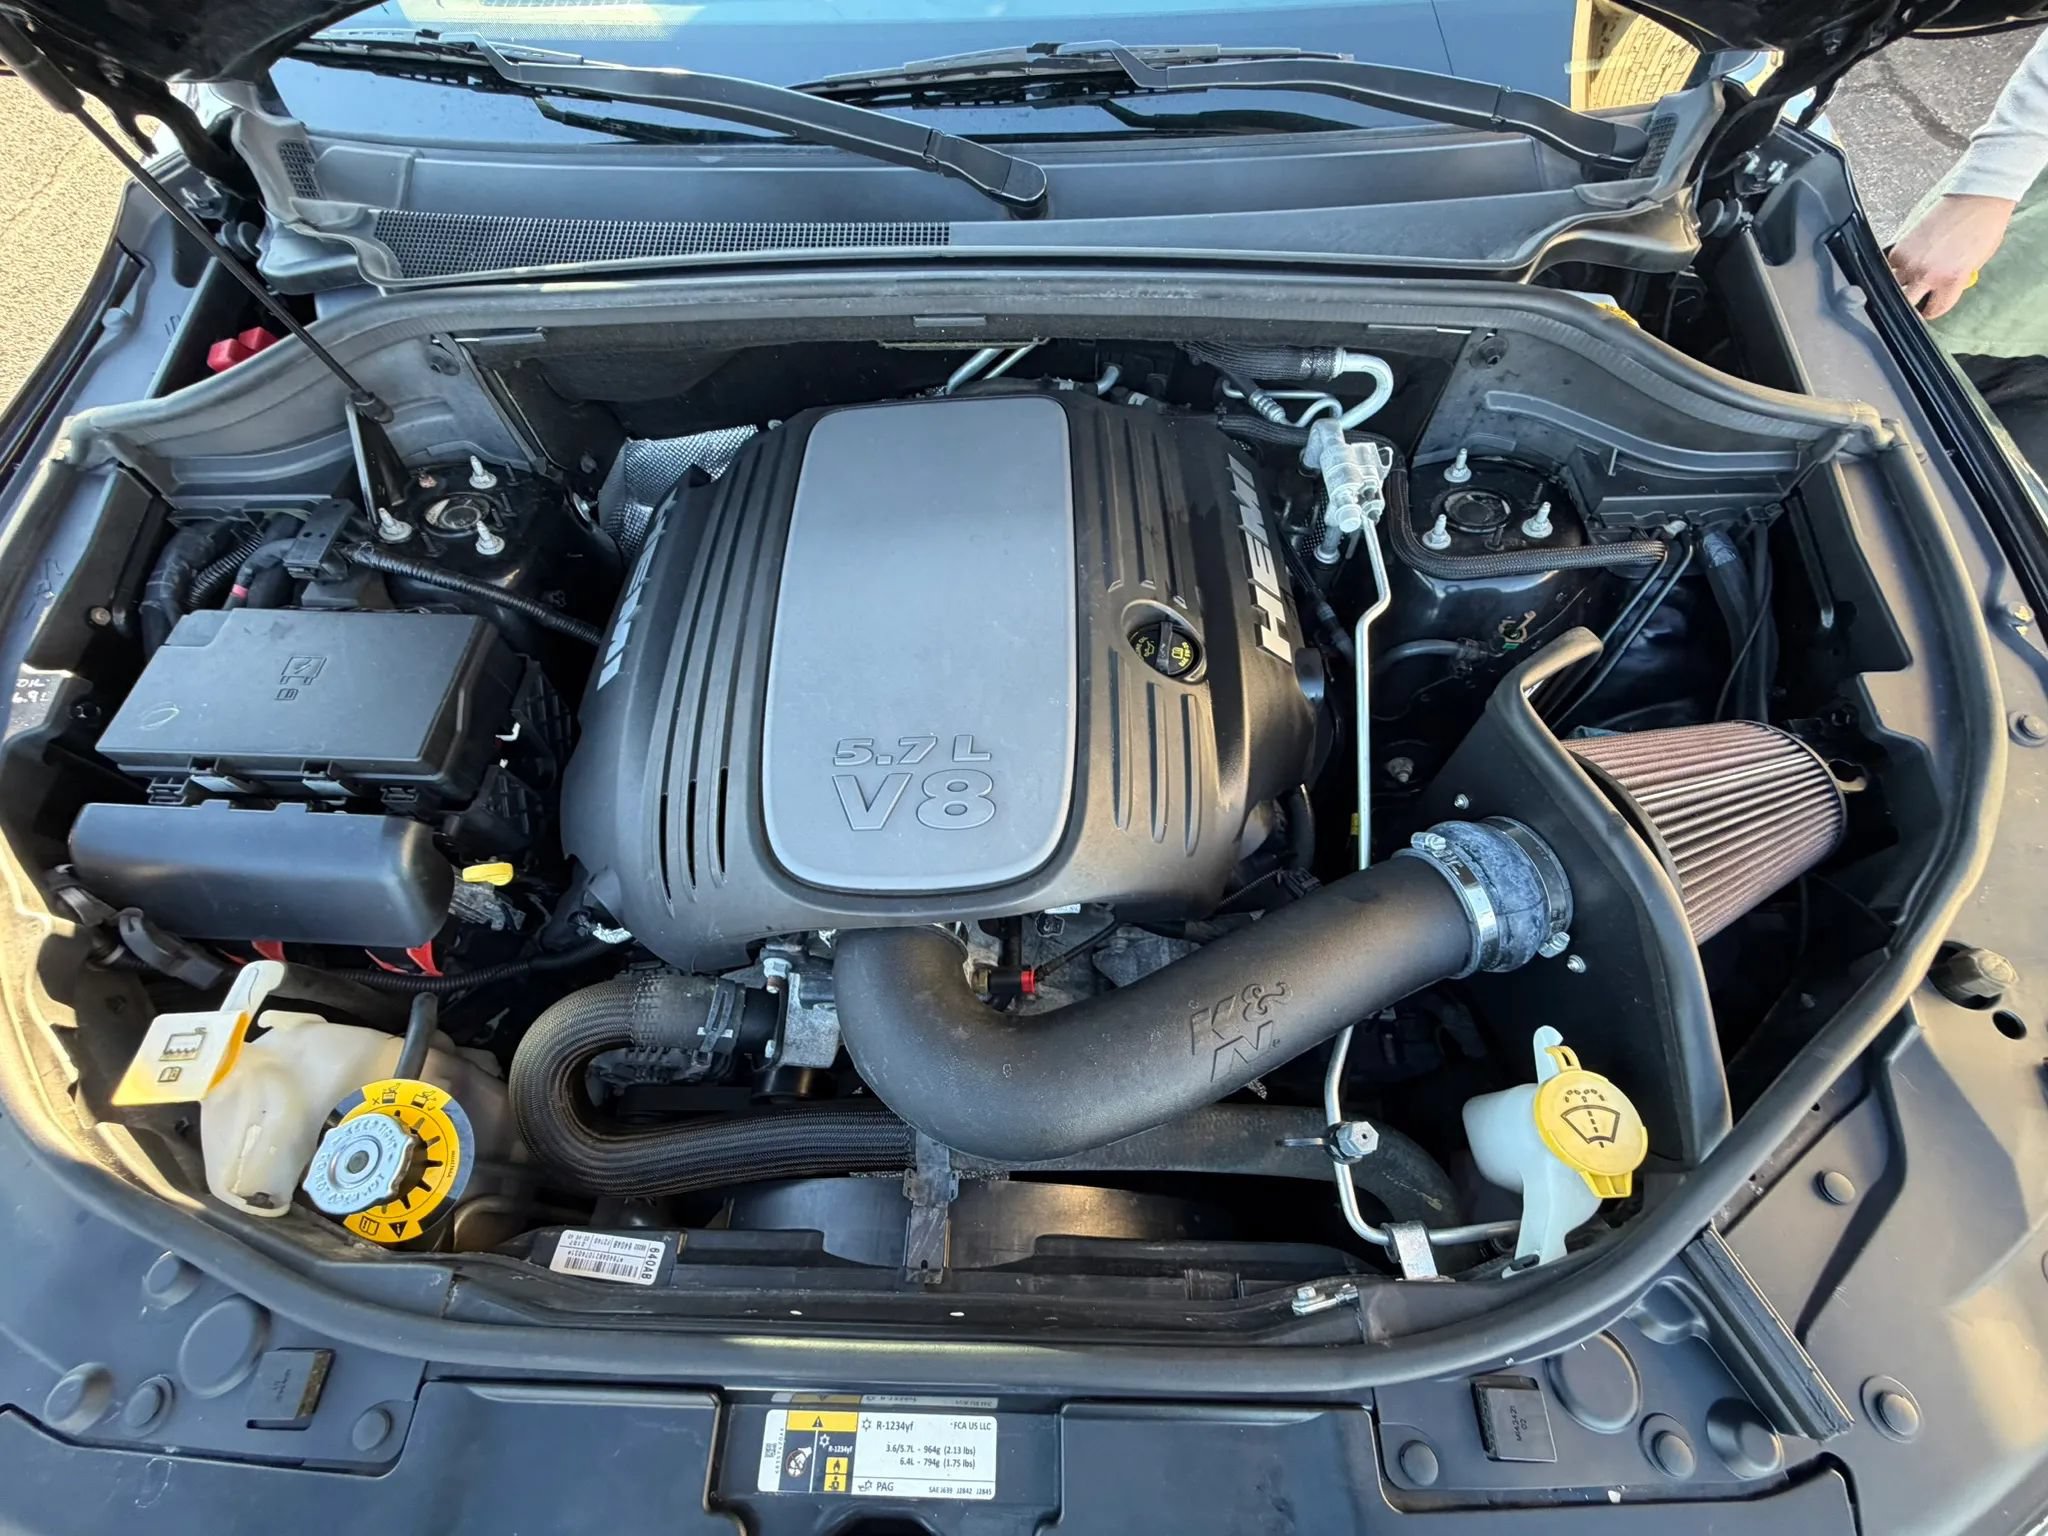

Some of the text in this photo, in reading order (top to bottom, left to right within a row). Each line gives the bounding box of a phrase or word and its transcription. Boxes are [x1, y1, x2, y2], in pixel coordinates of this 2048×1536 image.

[1228, 453, 1292, 664] HEMI
[833, 735, 992, 767] 5.7 L
[832, 768, 996, 831] V8
[876, 1420, 992, 1434] R-1234yf FCA US LLC
[828, 1445, 854, 1455] R-1234yf
[886, 1443, 915, 1454] 3.6/5.7L
[923, 1445, 941, 1456] 964g
[943, 1445, 961, 1456] (2.13
[963, 1445, 976, 1456] lbs)
[900, 1457, 915, 1466] 6.4L
[923, 1458, 940, 1469] 794g
[943, 1458, 961, 1469] (1.75
[963, 1458, 976, 1470] lbs)
[876, 1481, 894, 1492] PAG
